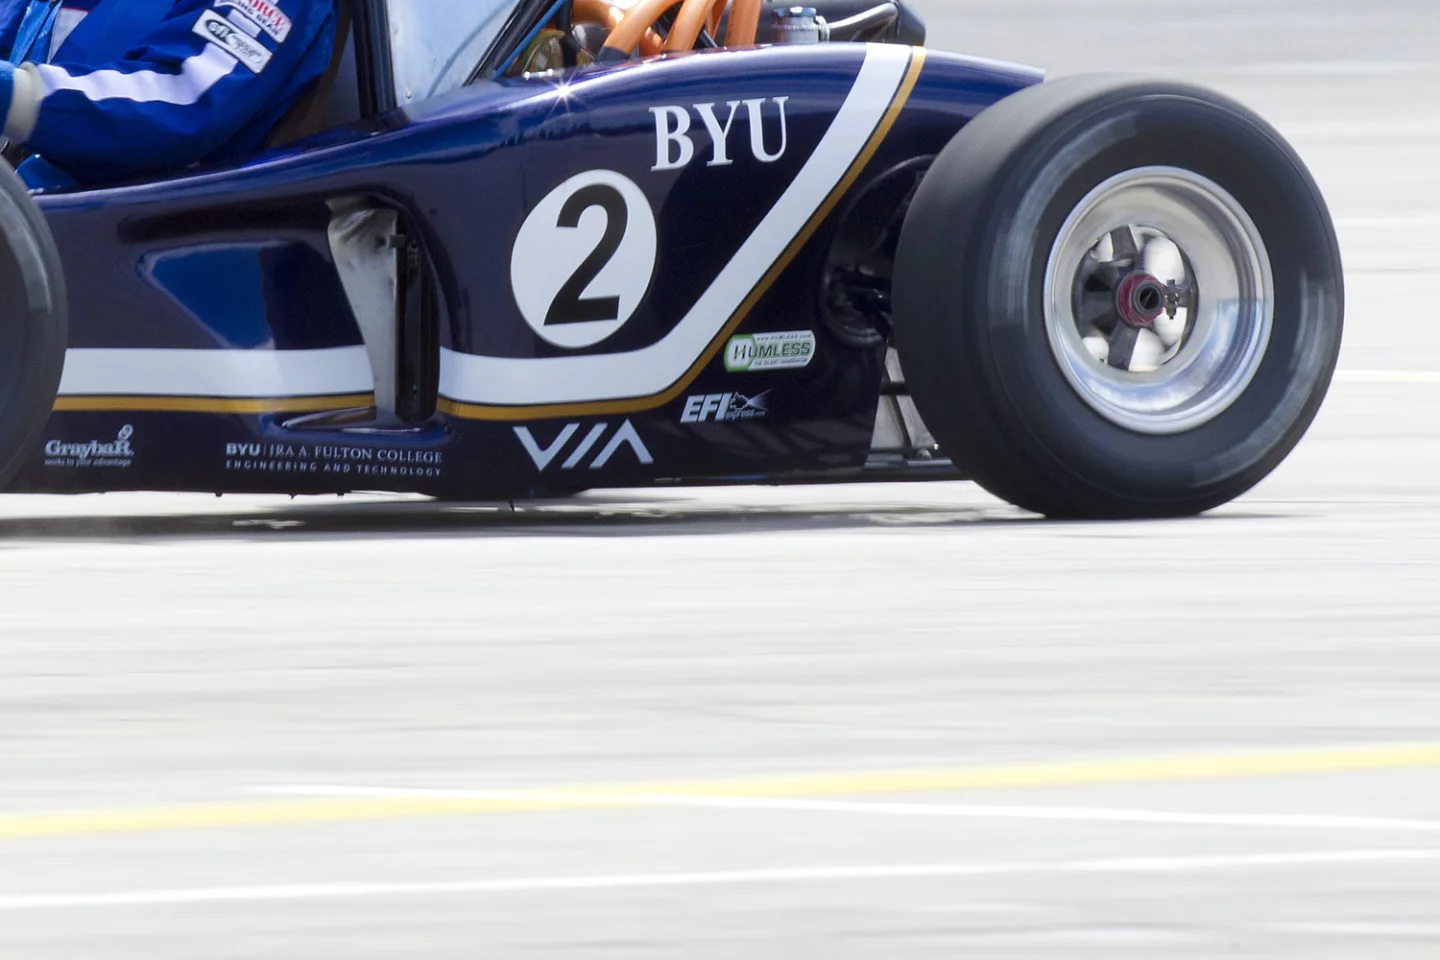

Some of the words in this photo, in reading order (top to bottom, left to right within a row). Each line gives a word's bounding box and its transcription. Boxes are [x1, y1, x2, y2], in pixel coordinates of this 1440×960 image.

[254, 13, 280, 36] GEAR
[648, 96, 789, 171] BYU
[543, 182, 628, 326] 2
[733, 342, 812, 361] HUMLESS
[680, 392, 733, 423] EFI
[226, 443, 261, 457] BYU
[269, 444, 294, 458] IRA
[315, 446, 373, 460] FULTON
[377, 448, 443, 464] COLLEGE
[513, 418, 653, 471] VIA
[92, 458, 131, 468] advantage
[225, 460, 317, 472] ENGINEERING
[323, 463, 351, 473] AND
[357, 464, 442, 477] TECHNOLOGY
